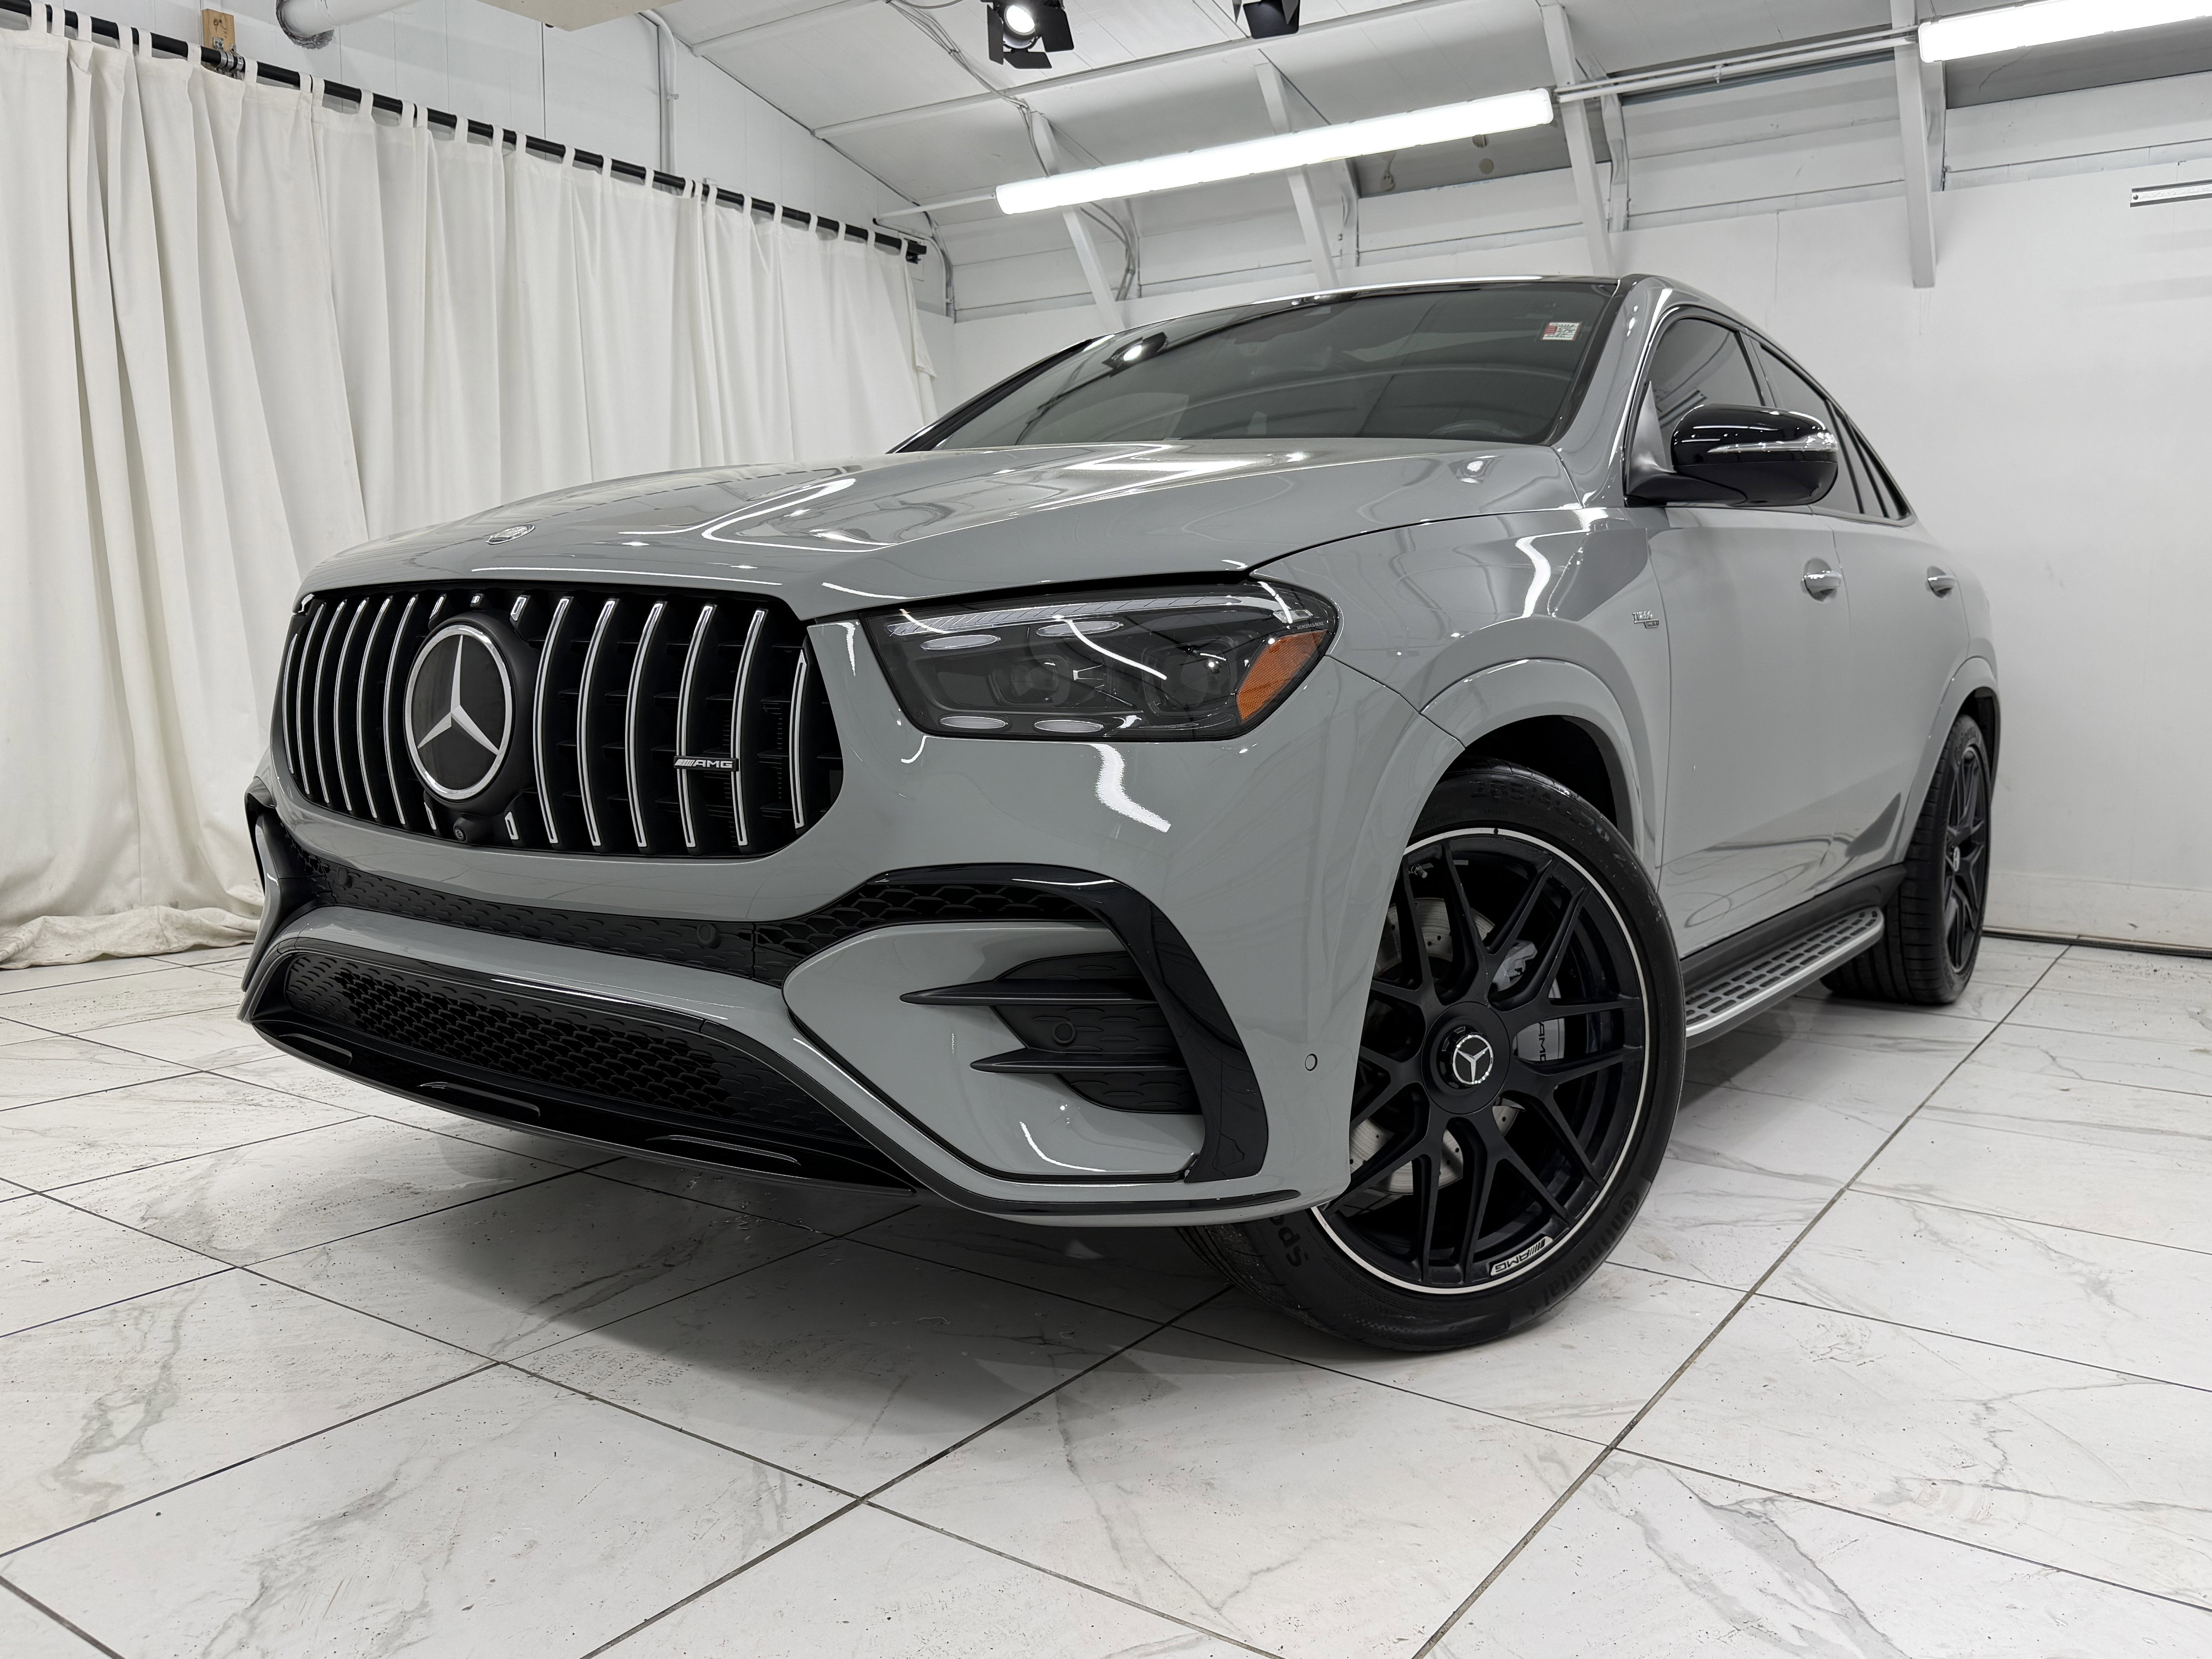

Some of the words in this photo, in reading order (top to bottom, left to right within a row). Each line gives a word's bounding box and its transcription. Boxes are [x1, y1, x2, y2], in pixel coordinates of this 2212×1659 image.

[693, 760, 733, 769] AMG
[1543, 1190, 1640, 1306] Continental
[1495, 1249, 1530, 1273] AMG
